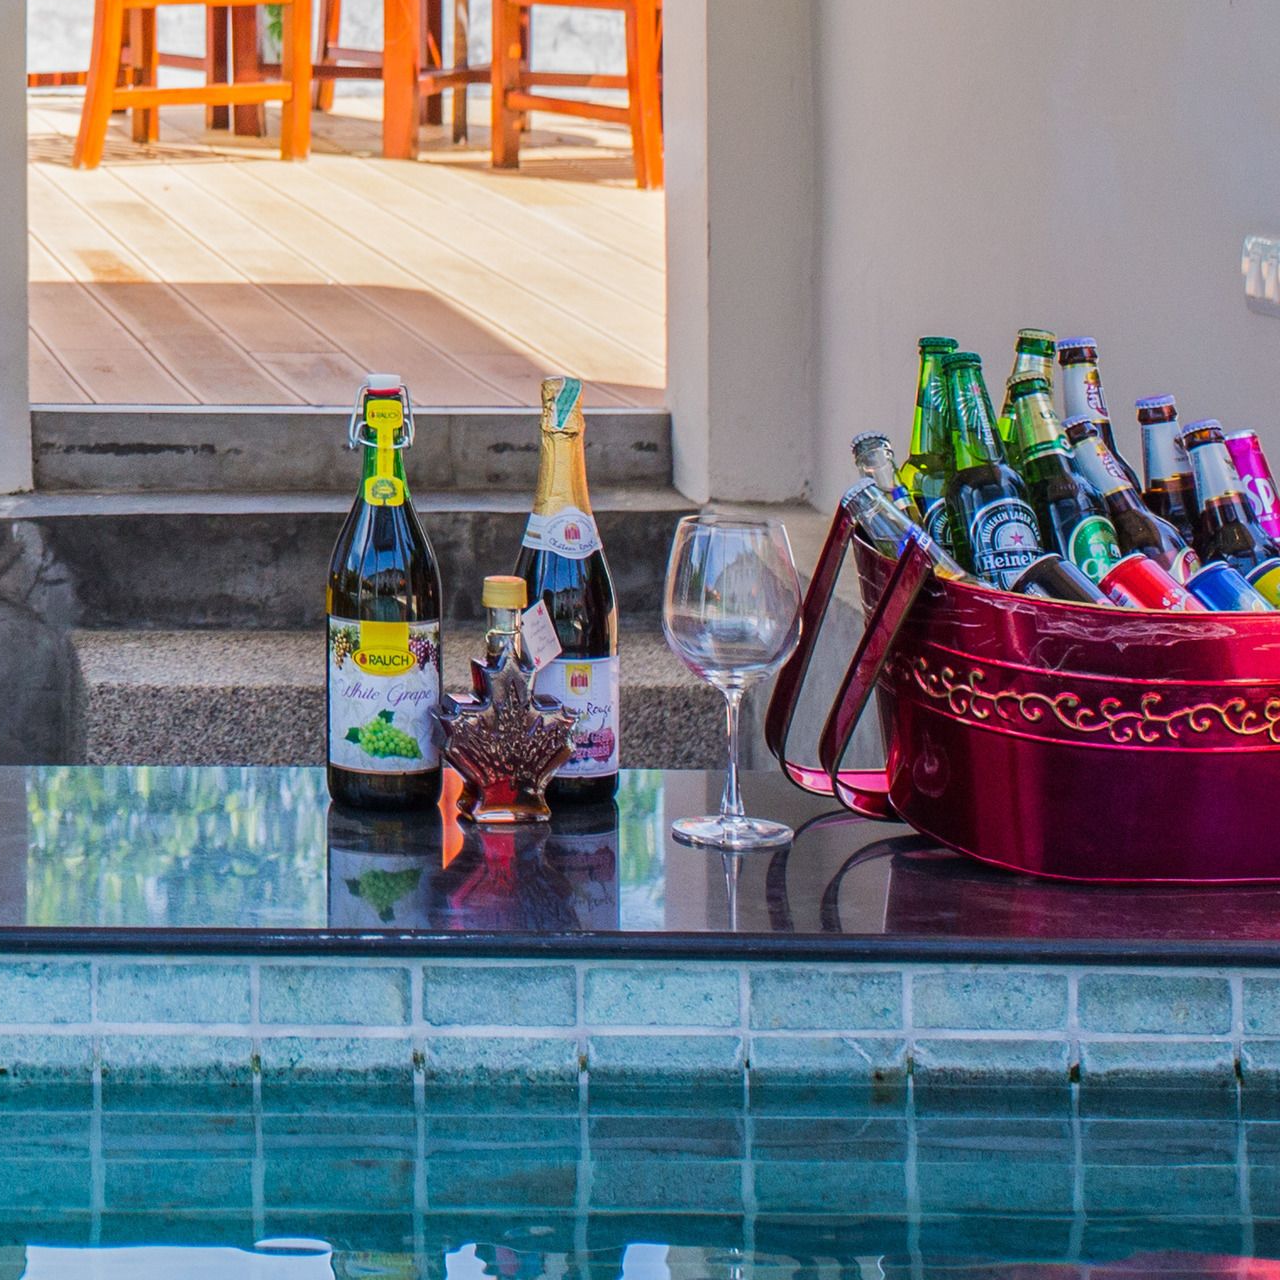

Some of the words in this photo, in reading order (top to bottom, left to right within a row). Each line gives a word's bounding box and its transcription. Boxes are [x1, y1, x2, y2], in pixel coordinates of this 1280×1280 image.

[981, 551, 1042, 571] Heinek
[368, 654, 409, 666] RAUCH
[338, 678, 381, 701] White
[387, 683, 433, 707] Grape
